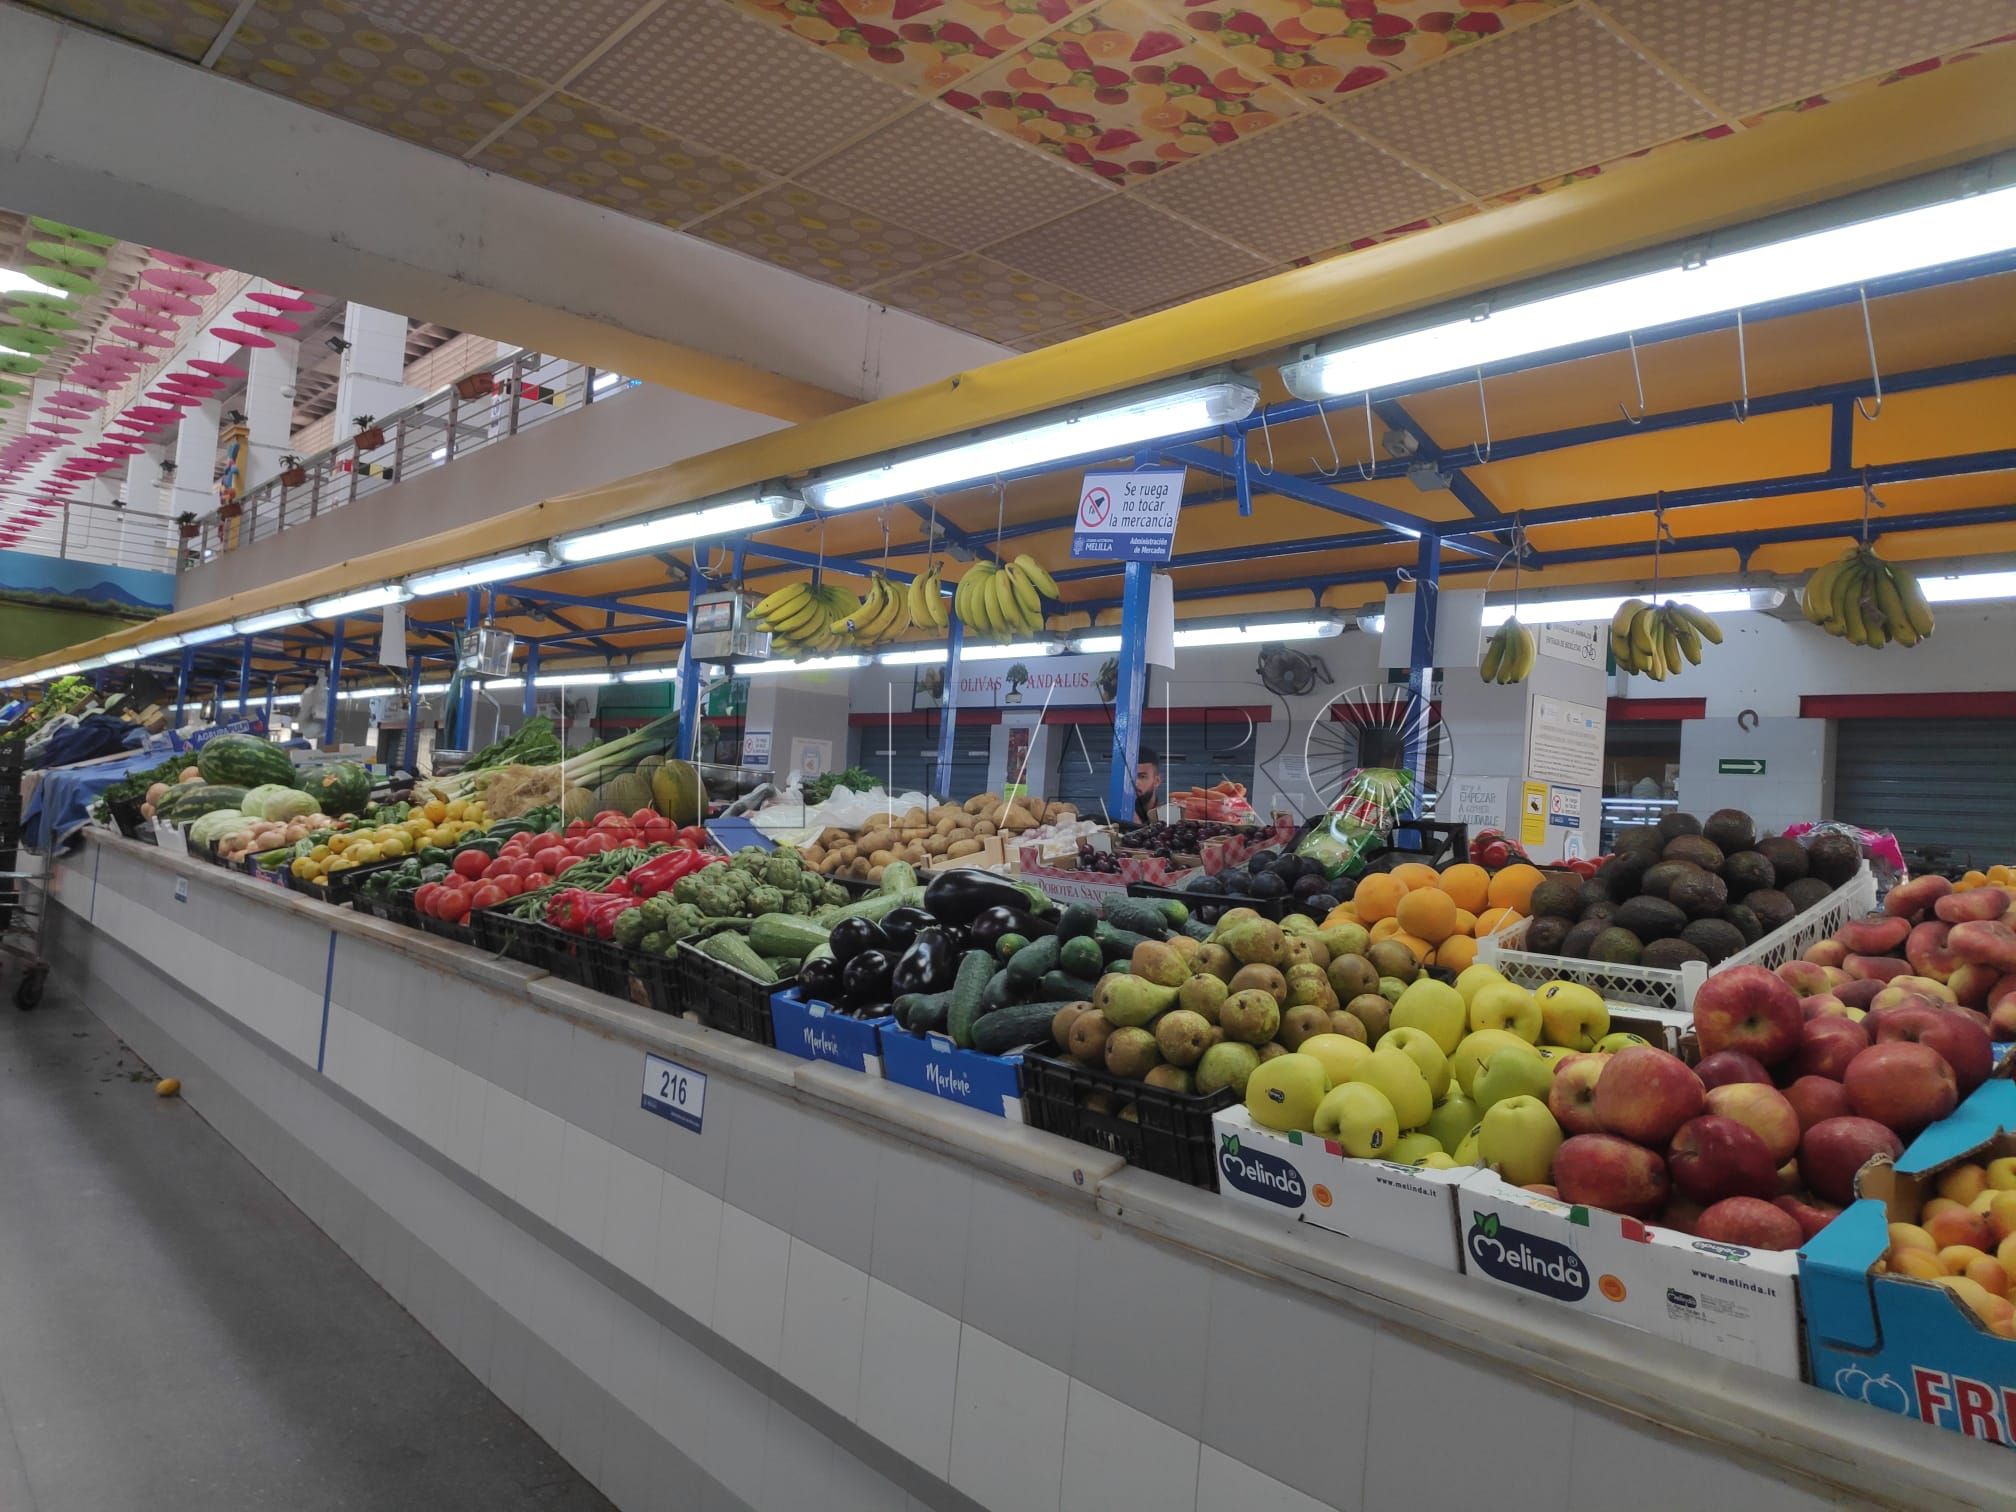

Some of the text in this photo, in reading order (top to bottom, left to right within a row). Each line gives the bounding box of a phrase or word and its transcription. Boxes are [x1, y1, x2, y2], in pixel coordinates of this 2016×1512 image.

[1124, 482, 1168, 499] Se ruega
[1122, 499, 1165, 512] no tocar
[1109, 513, 1117, 527] la
[1085, 543, 1112, 551] MELILLA
[1141, 546, 1165, 554] Mercados
[961, 673, 1089, 692] OLIVAS ANDALUS
[804, 1026, 839, 1055] Marlene
[660, 1070, 687, 1105] 216
[926, 1063, 970, 1096] Marlene
[1223, 1153, 1302, 1196] Melinda
[1376, 1177, 1437, 1197] www.melinda.it
[1473, 1234, 1583, 1289] Melinda
[1692, 1268, 1776, 1297] www.melinda.it
